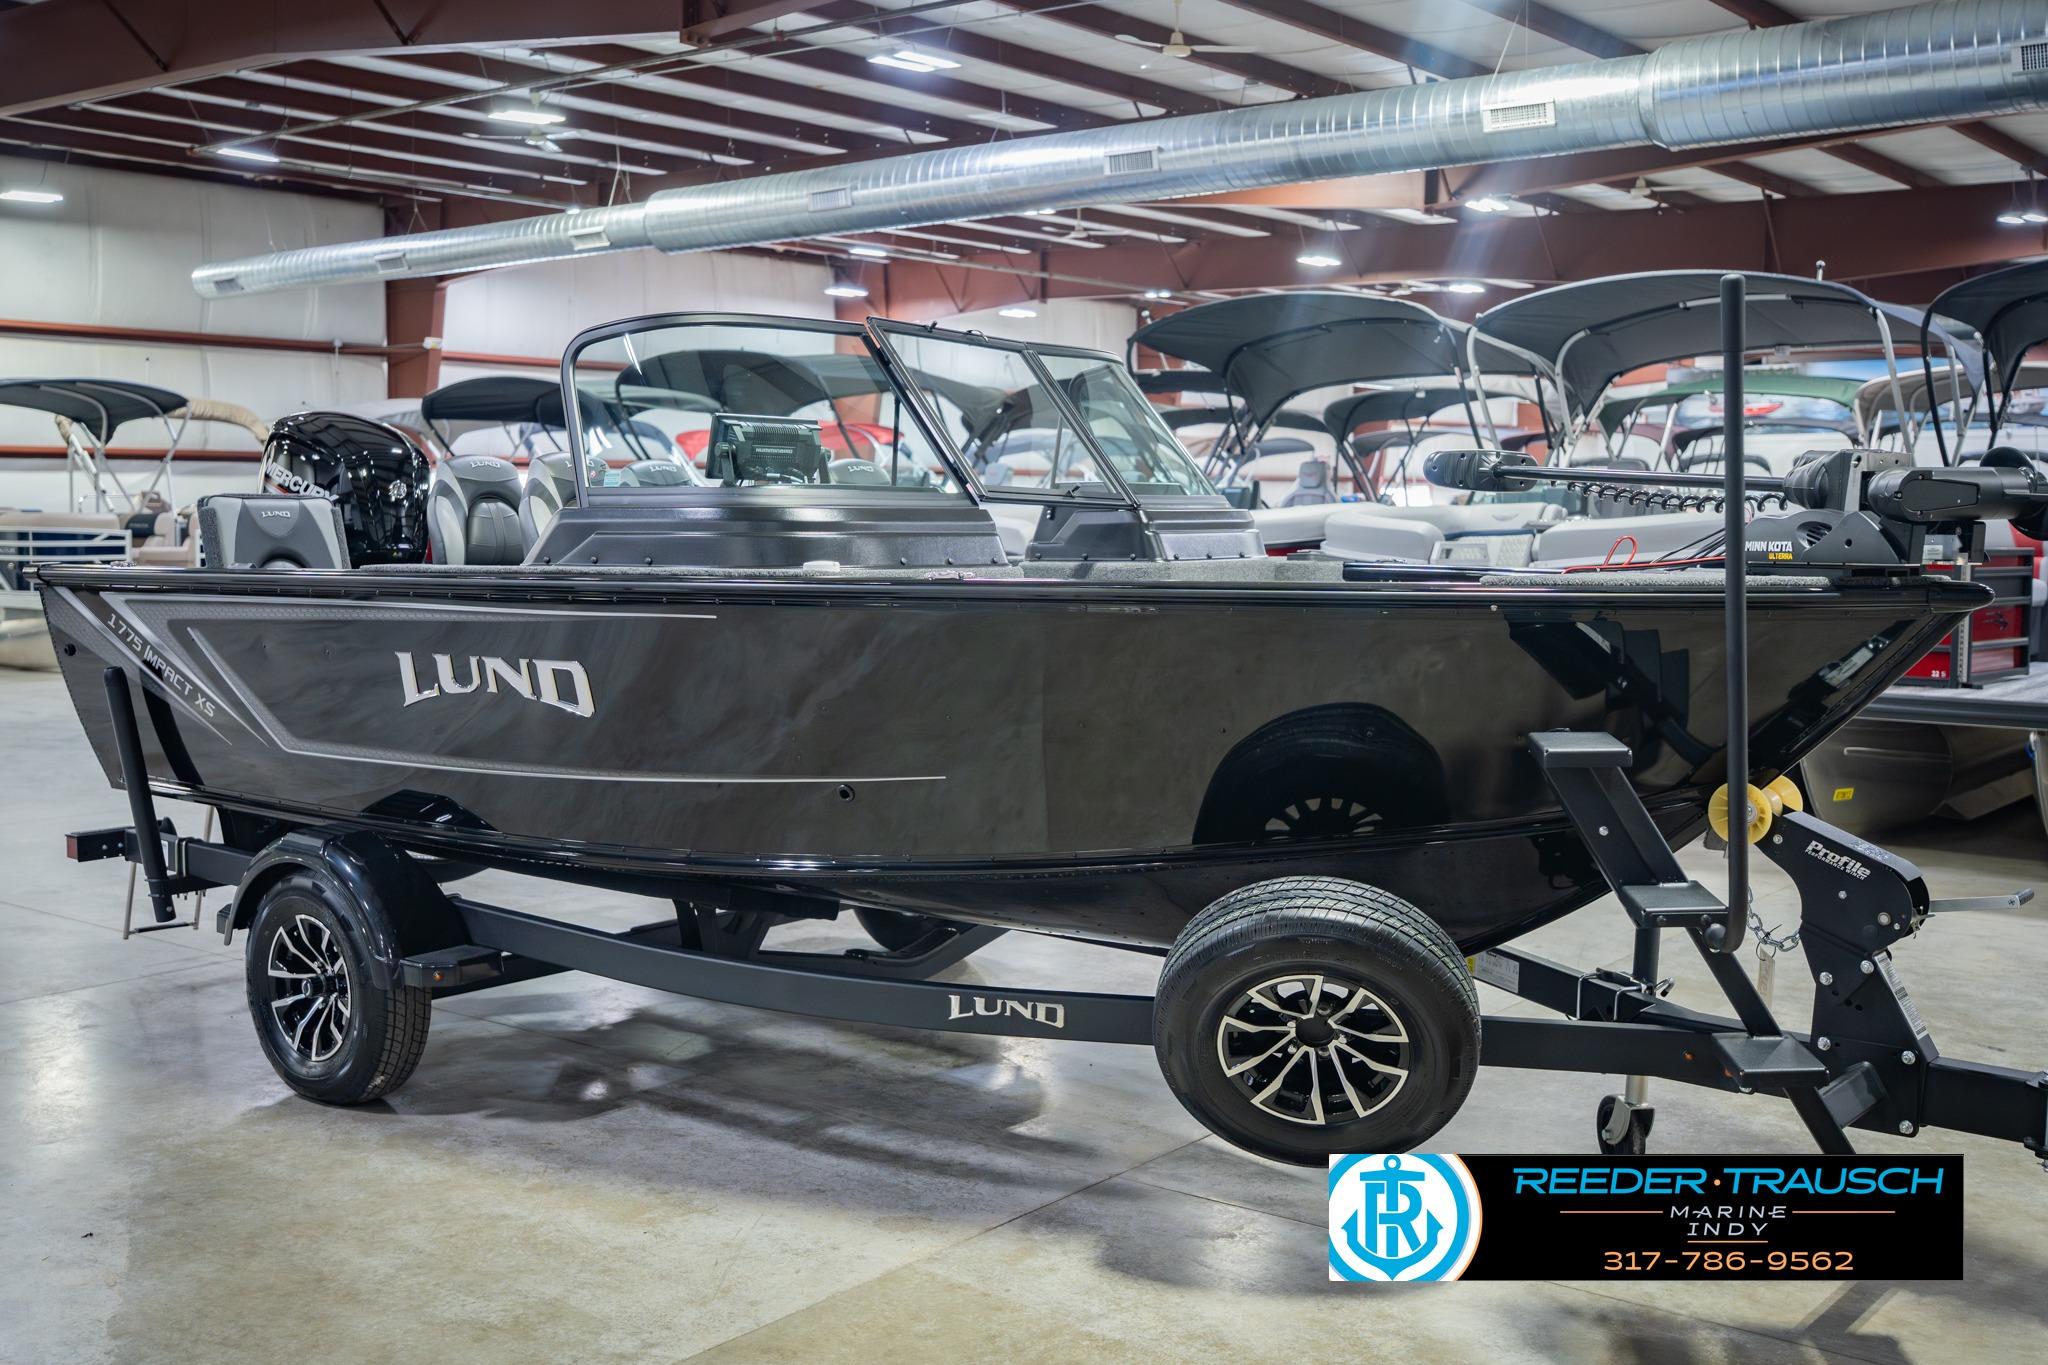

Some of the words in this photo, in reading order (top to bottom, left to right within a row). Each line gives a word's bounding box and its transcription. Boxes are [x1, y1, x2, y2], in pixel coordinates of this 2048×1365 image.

[265, 460, 339, 501] MERCURY
[469, 460, 501, 469] LUND
[649, 465, 678, 473] LUND
[261, 510, 291, 518] LUND
[1744, 541, 1767, 552] MINN
[1768, 541, 1793, 552] KOTA
[1768, 552, 1793, 560] ULTERRA
[107, 613, 143, 652] 1775
[143, 645, 193, 695] IMPACT
[194, 693, 216, 718] XS
[395, 651, 596, 718] LUND
[1804, 849, 1845, 872] PERFORMANCE
[1845, 868, 1866, 881] WINCH
[1805, 840, 1871, 878] Profile
[948, 994, 1065, 1029] LUND
